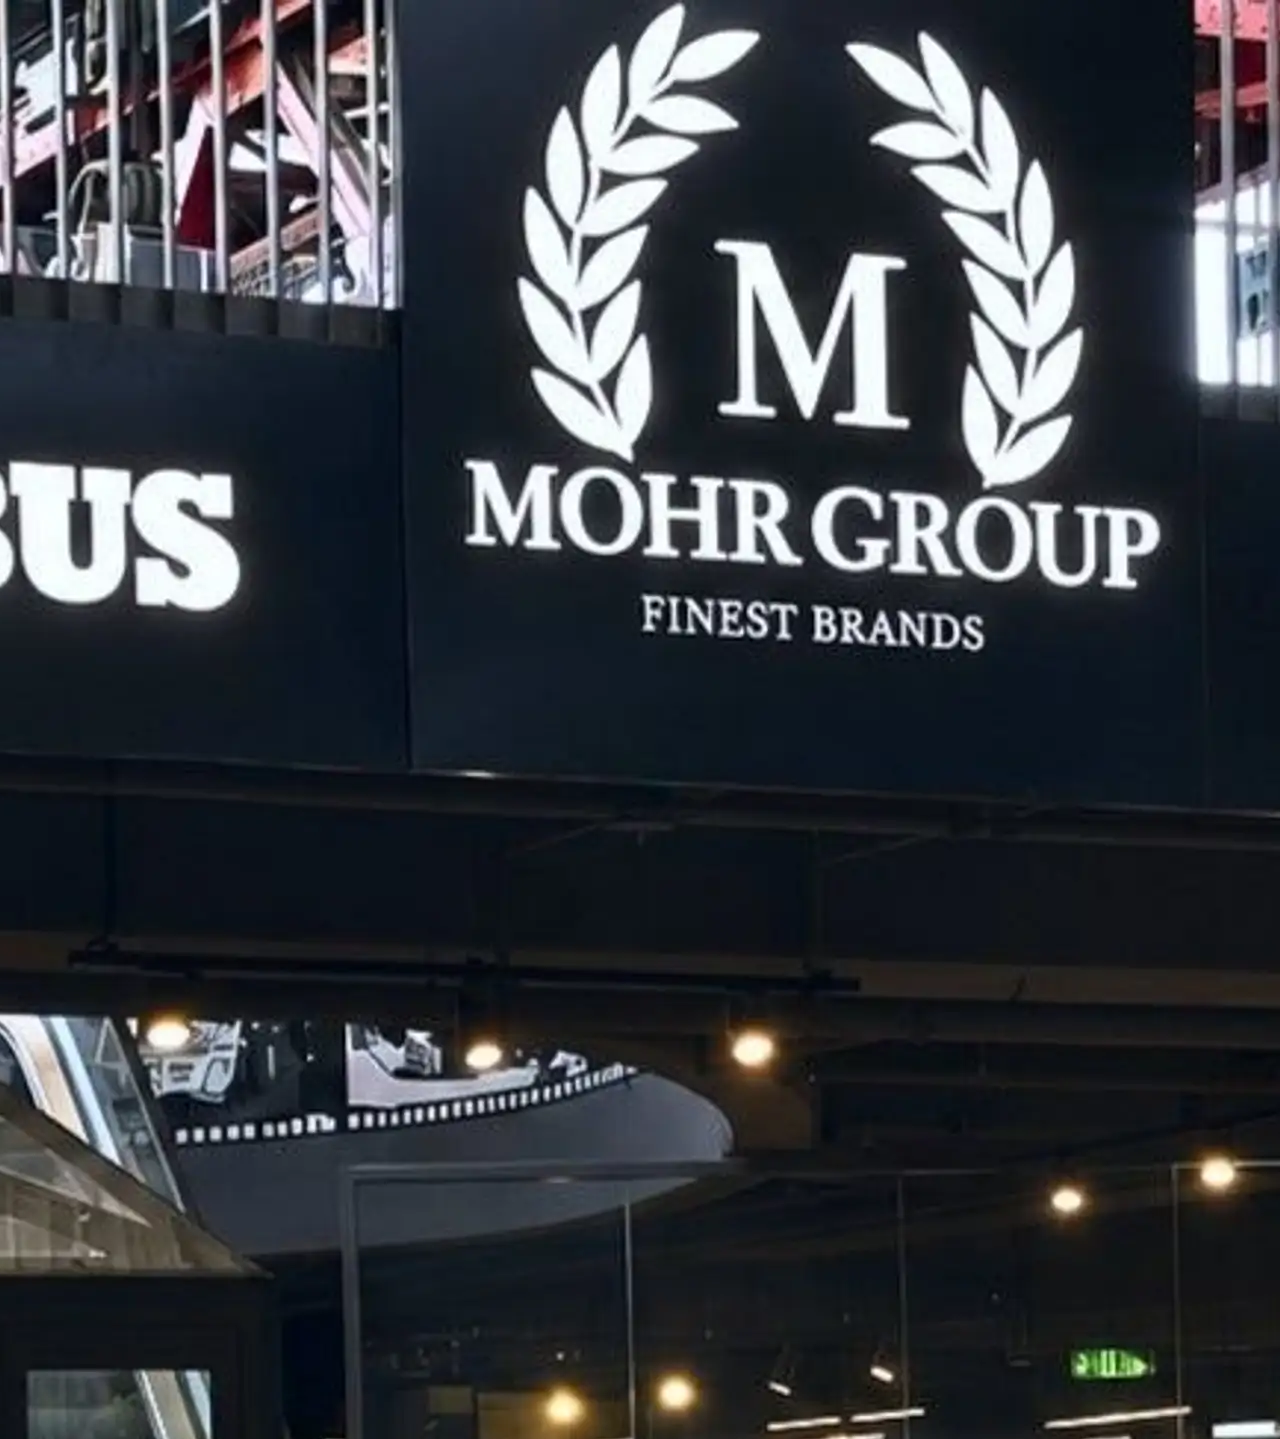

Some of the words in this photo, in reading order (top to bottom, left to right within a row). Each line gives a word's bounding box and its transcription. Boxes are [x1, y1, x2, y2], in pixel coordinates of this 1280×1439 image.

[714, 239, 910, 429] M
[464, 459, 803, 567] MOHR
[811, 486, 1161, 589] GROUP
[641, 594, 798, 642] FINEST
[813, 606, 985, 651] BRANDS
